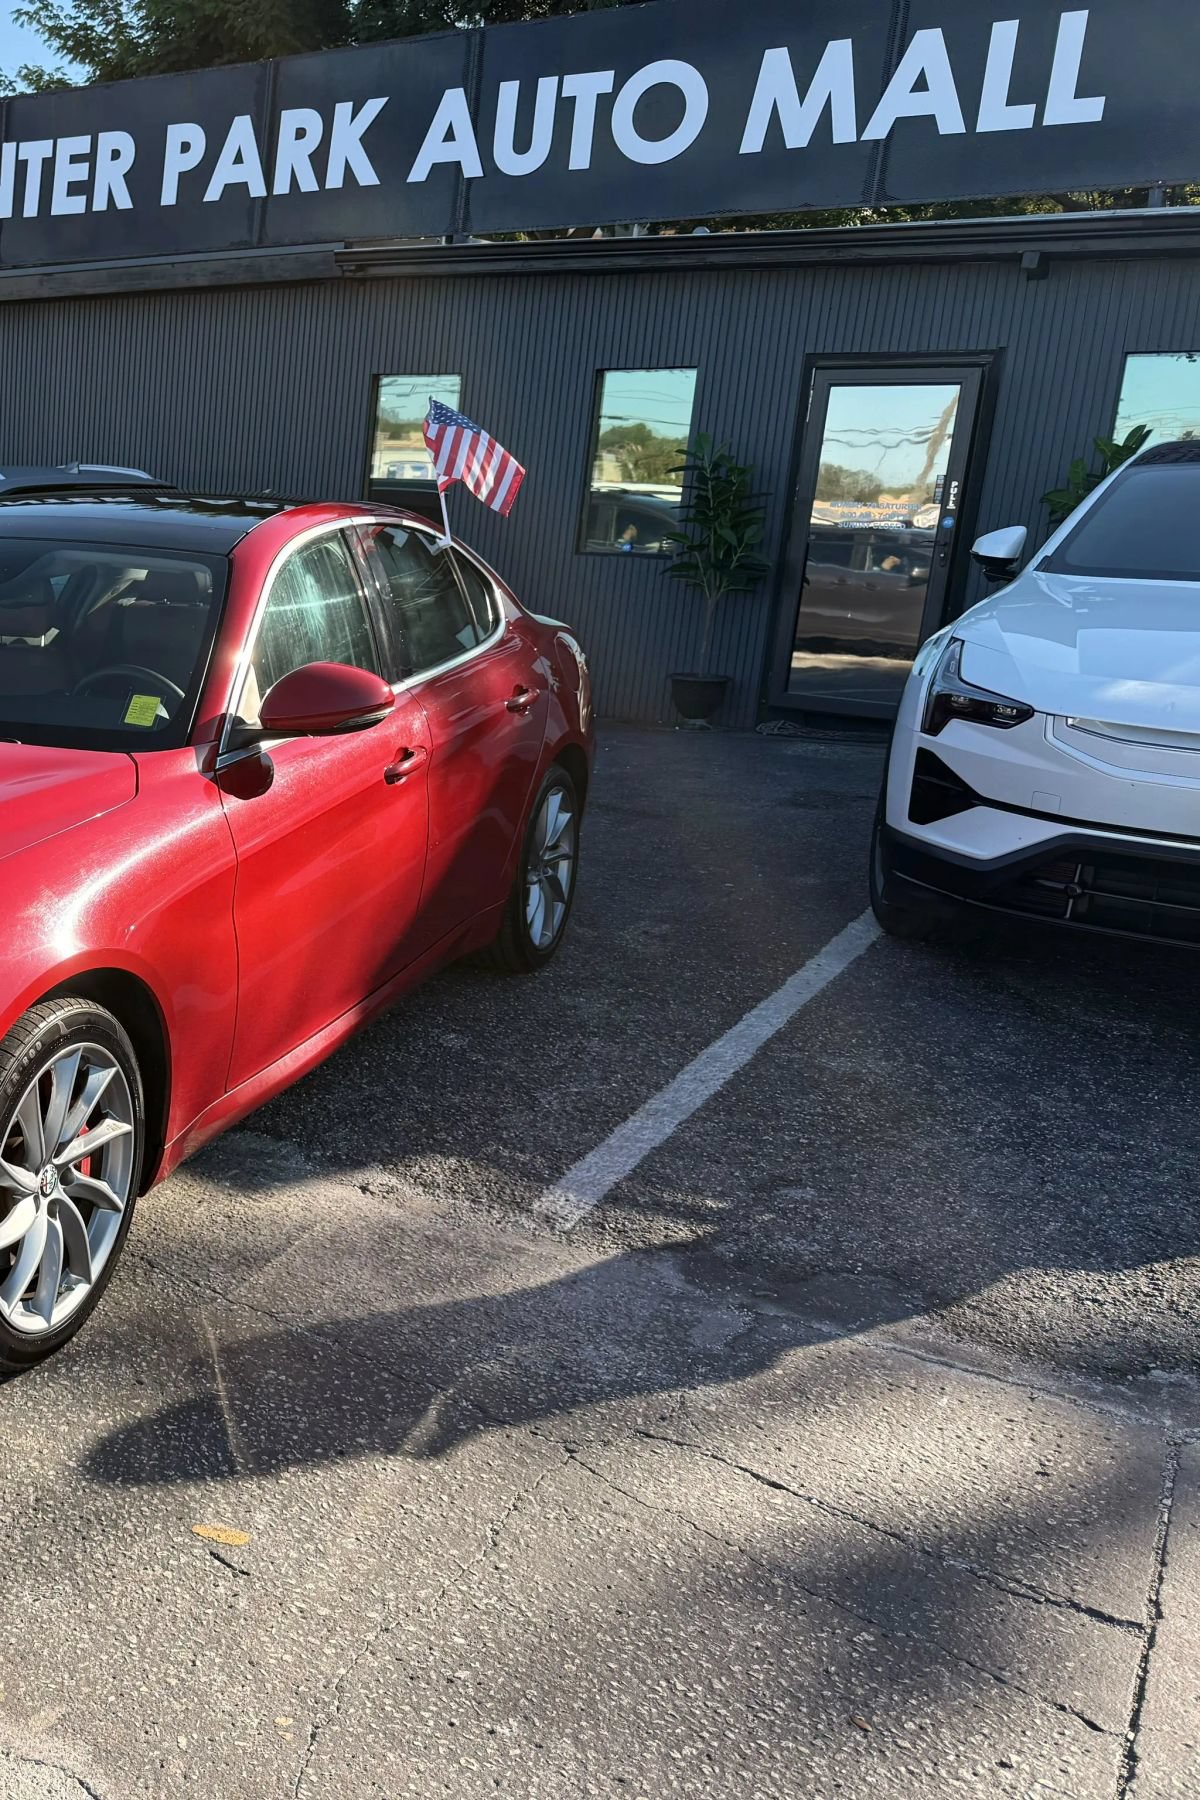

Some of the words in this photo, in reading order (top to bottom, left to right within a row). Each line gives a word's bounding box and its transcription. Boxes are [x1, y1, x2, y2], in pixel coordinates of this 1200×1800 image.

[160, 97, 389, 206] PARK
[406, 59, 709, 183] AUTO
[739, 9, 1106, 155] MALL
[948, 481, 958, 507] PULL
